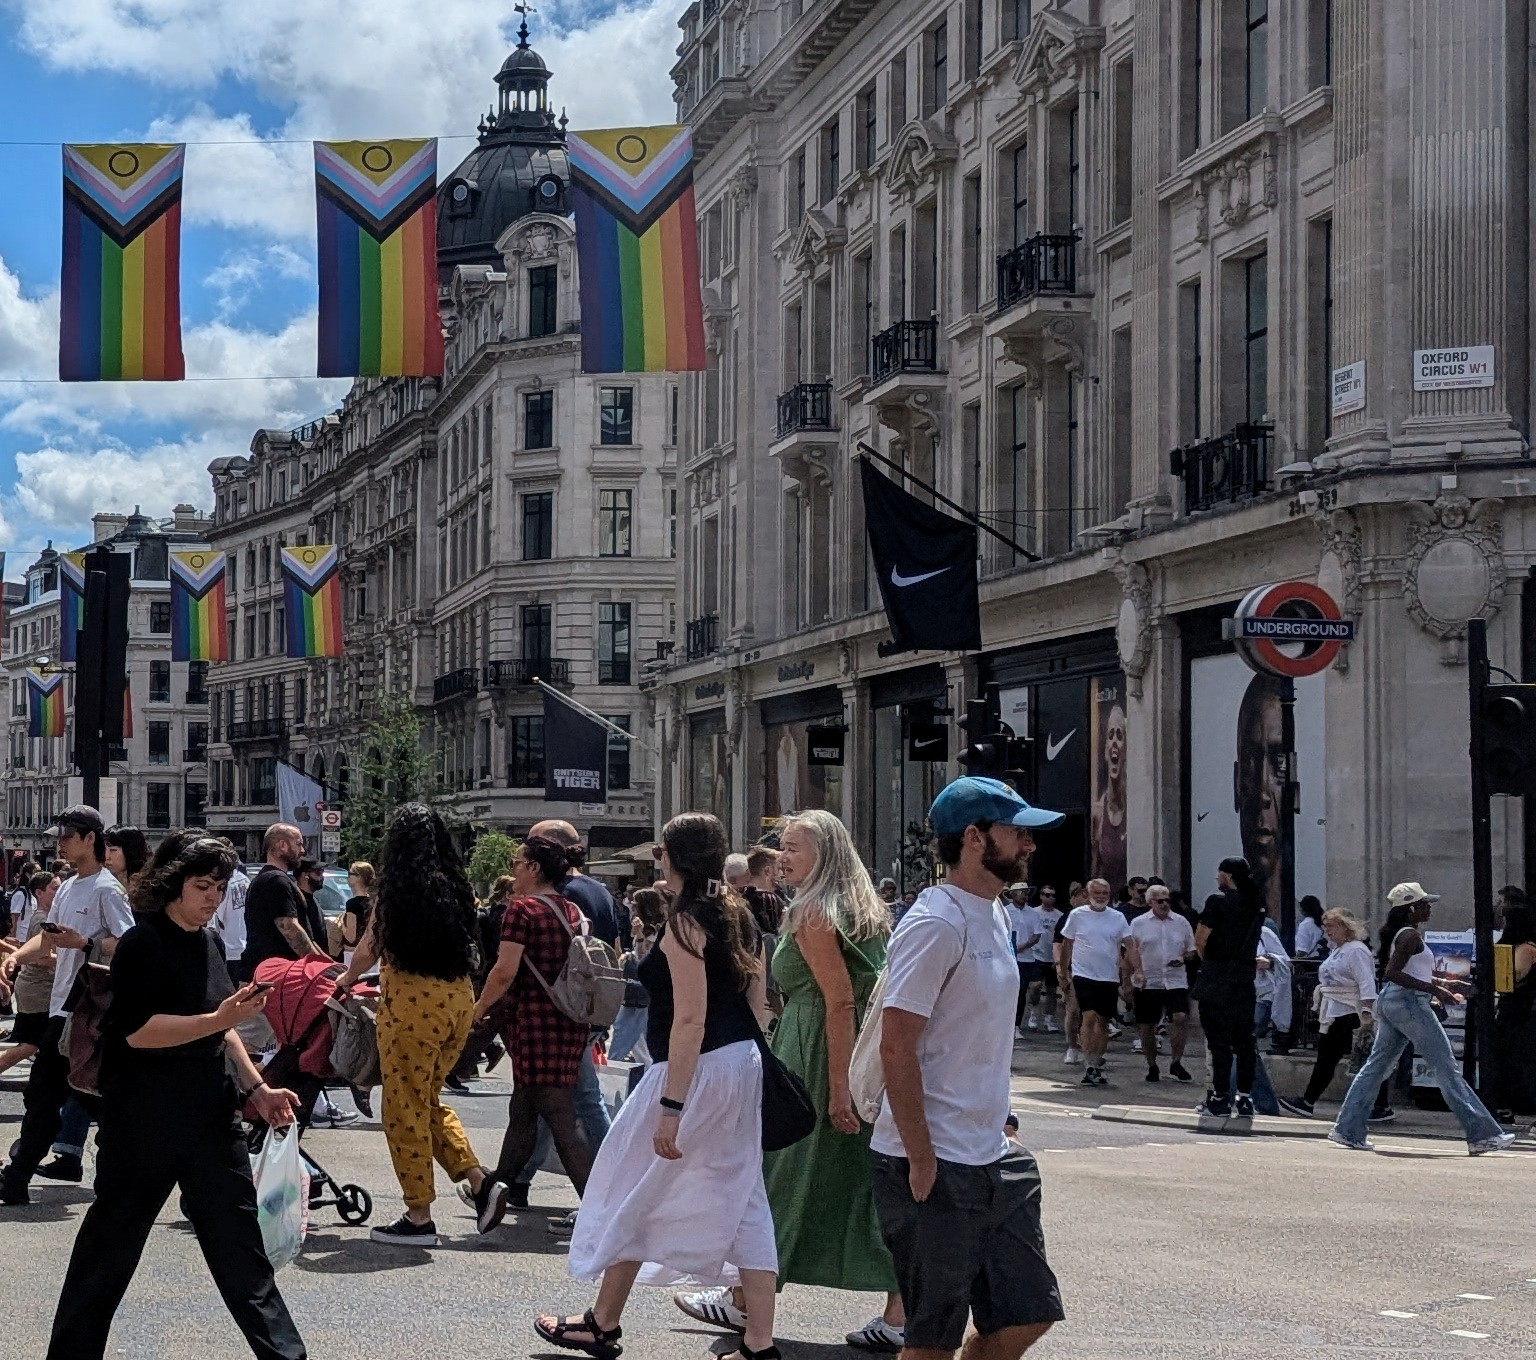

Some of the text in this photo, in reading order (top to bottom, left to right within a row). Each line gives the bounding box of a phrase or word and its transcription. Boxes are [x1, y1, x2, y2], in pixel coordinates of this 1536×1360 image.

[1421, 351, 1469, 365] OXFORD
[1421, 362, 1487, 377] CIRCUS W1
[1247, 621, 1349, 636] UNDERGROUND
[553, 775, 601, 790] TIGER
